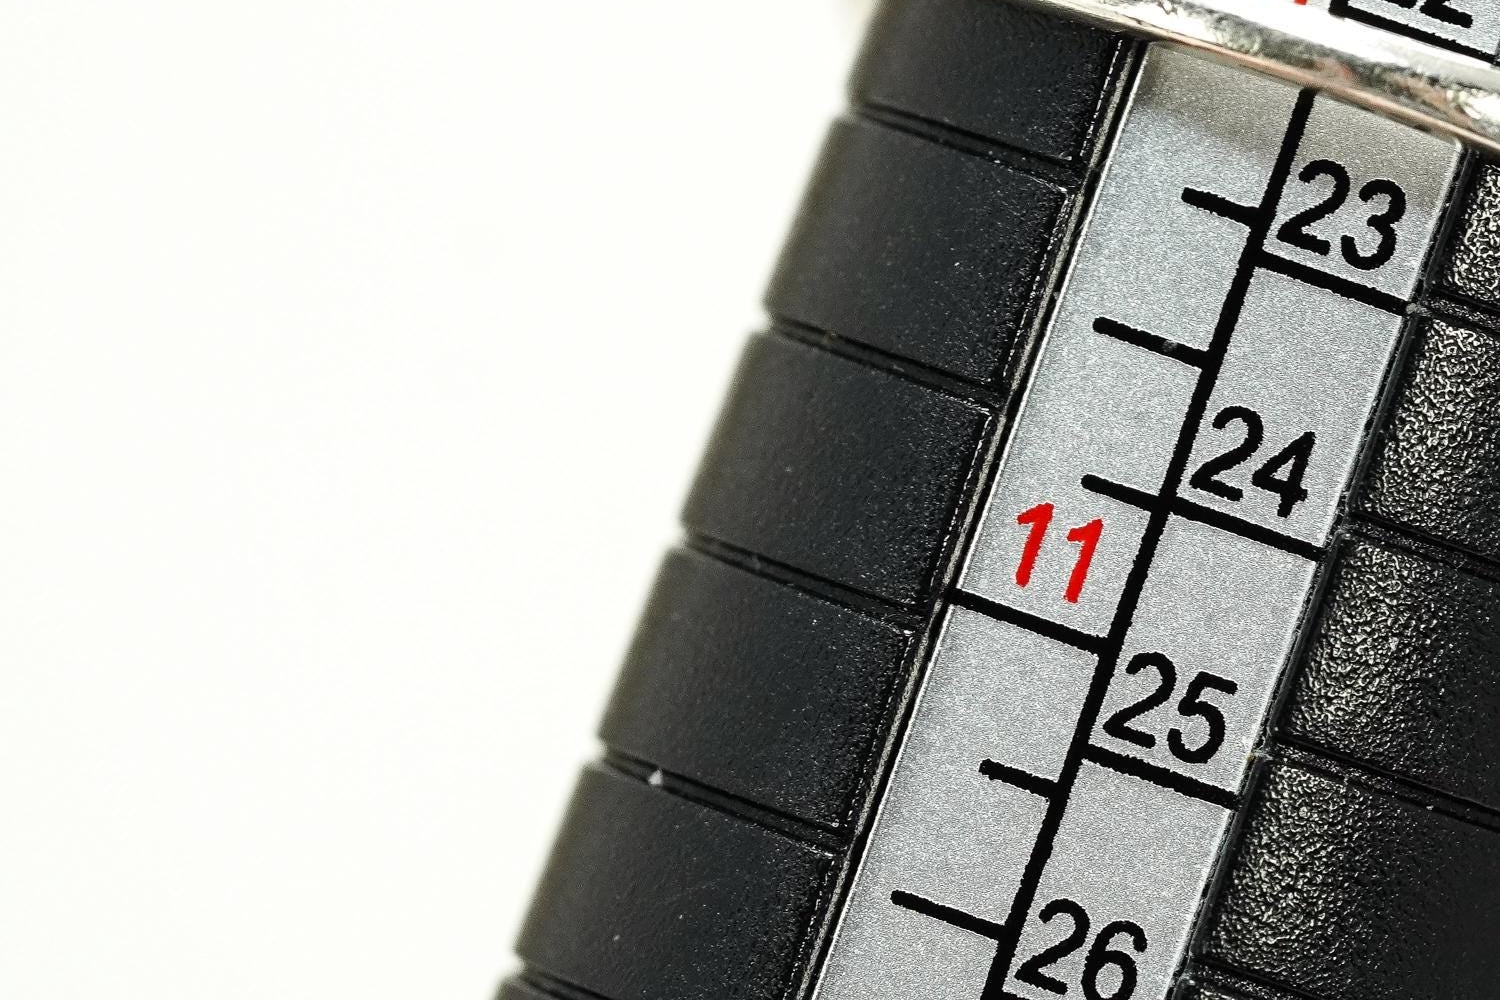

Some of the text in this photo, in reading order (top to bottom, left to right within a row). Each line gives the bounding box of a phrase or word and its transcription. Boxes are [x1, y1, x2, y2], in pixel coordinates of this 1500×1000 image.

[1275, 158, 1408, 272] 23
[1188, 405, 1318, 519] 24
[1015, 502, 1104, 604] 11
[1101, 651, 1239, 765] 25
[1013, 897, 1148, 1000] 26
